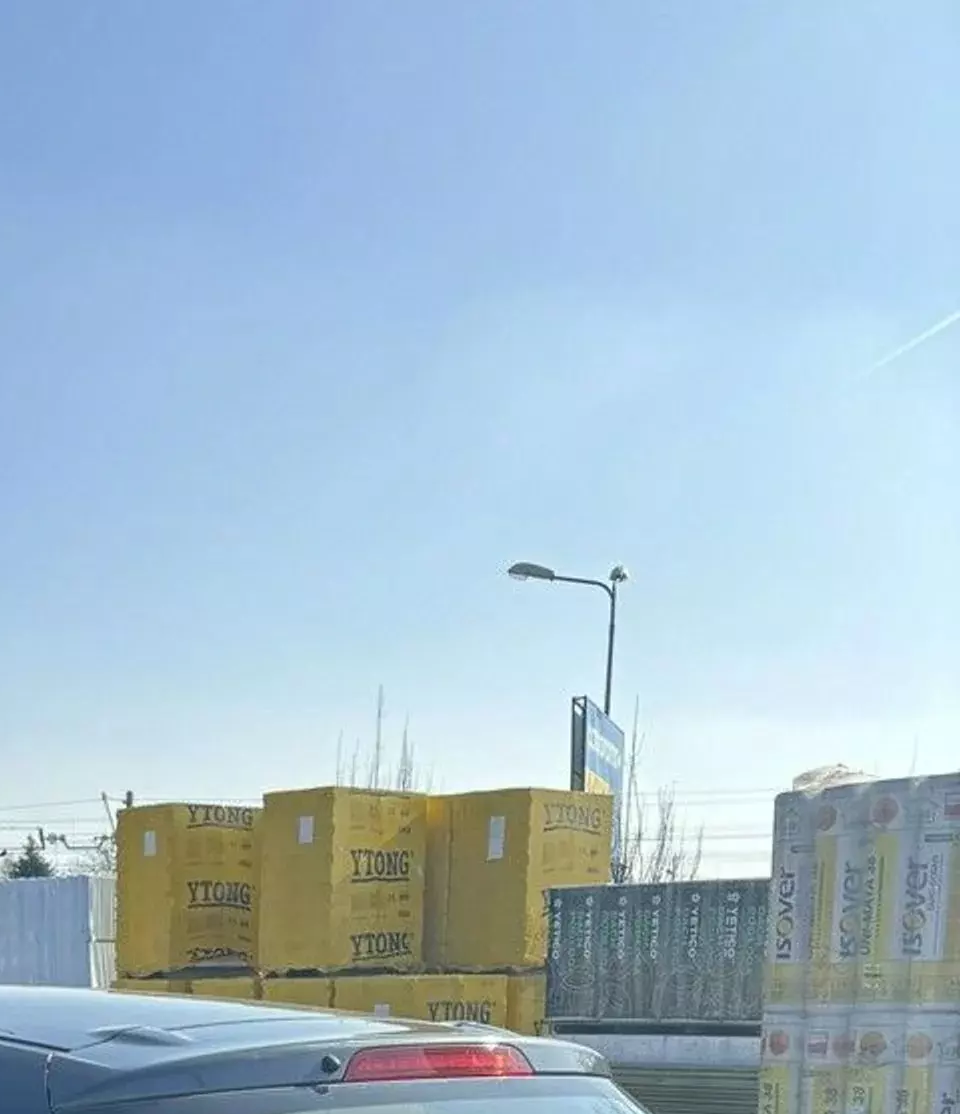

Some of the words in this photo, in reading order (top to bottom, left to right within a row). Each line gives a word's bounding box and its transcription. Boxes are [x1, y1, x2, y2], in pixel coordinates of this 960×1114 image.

[188, 805, 253, 826] YTONG
[542, 803, 601, 829] YTONG
[350, 848, 409, 876] YTONG
[187, 880, 252, 905] YTONG
[428, 1000, 491, 1023] YTONG
